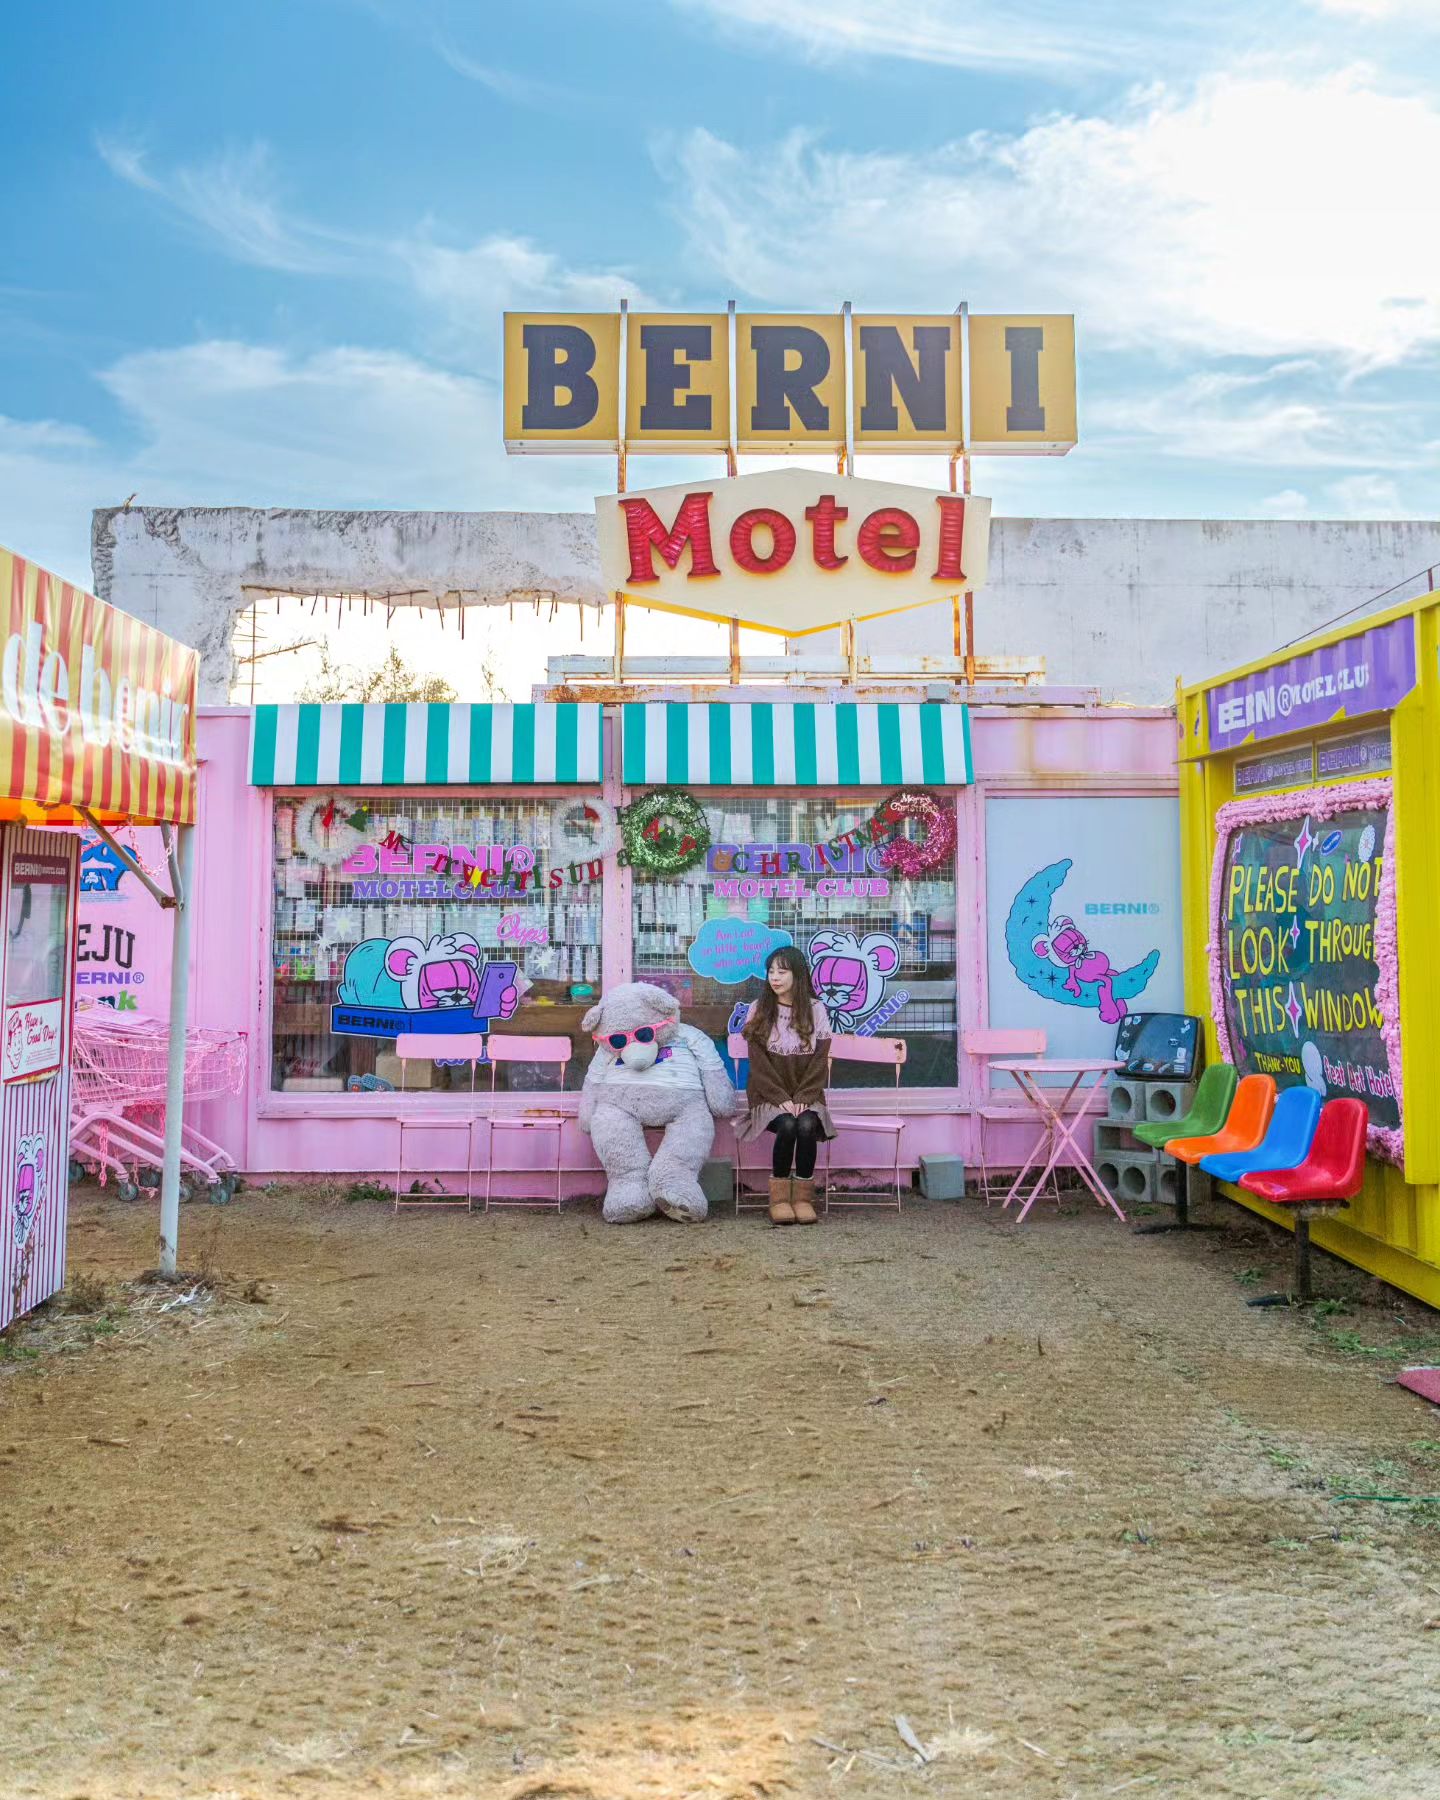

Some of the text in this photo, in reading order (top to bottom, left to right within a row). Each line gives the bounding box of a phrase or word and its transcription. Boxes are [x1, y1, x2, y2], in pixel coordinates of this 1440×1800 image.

[522, 324, 1045, 431] BERNI
[618, 492, 967, 583] Motel
[352, 879, 527, 899] MOTEL CLUB
[714, 878, 889, 898] MOTEL CLUB
[1228, 857, 1383, 920] PLEASE DO NOT
[1228, 925, 1289, 980] LOOK
[1235, 981, 1383, 1037] THIS WINDOW
